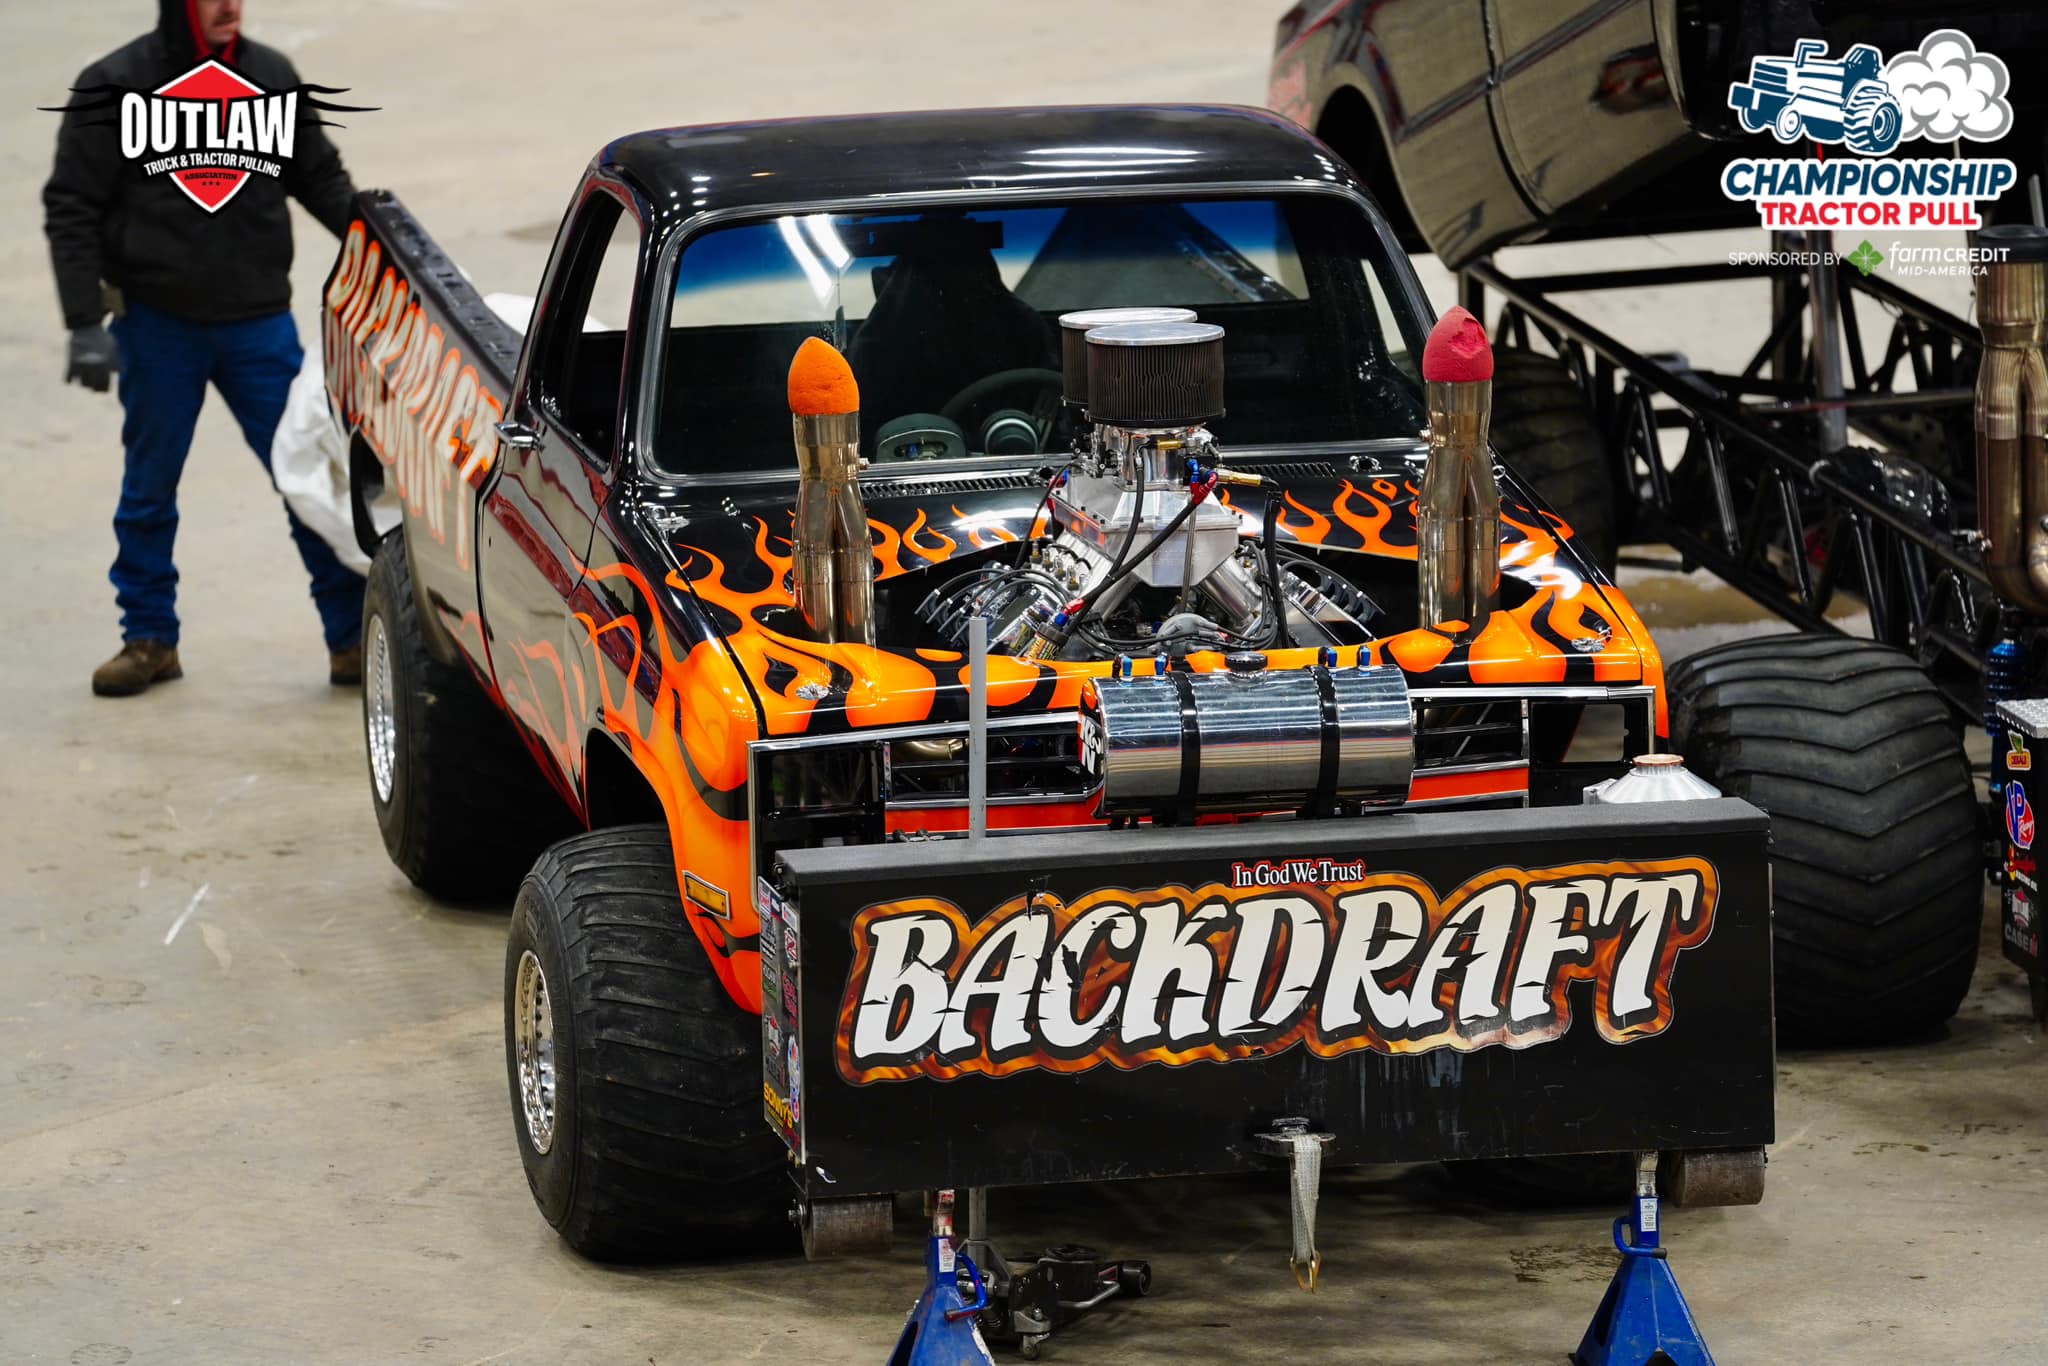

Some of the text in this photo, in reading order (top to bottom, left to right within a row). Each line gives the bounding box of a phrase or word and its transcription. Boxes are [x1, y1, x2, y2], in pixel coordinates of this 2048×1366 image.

[2006, 780, 2025, 846] VP
[1235, 861, 1363, 886] In God We Trust
[853, 874, 1695, 1059] BACKDRAFT
